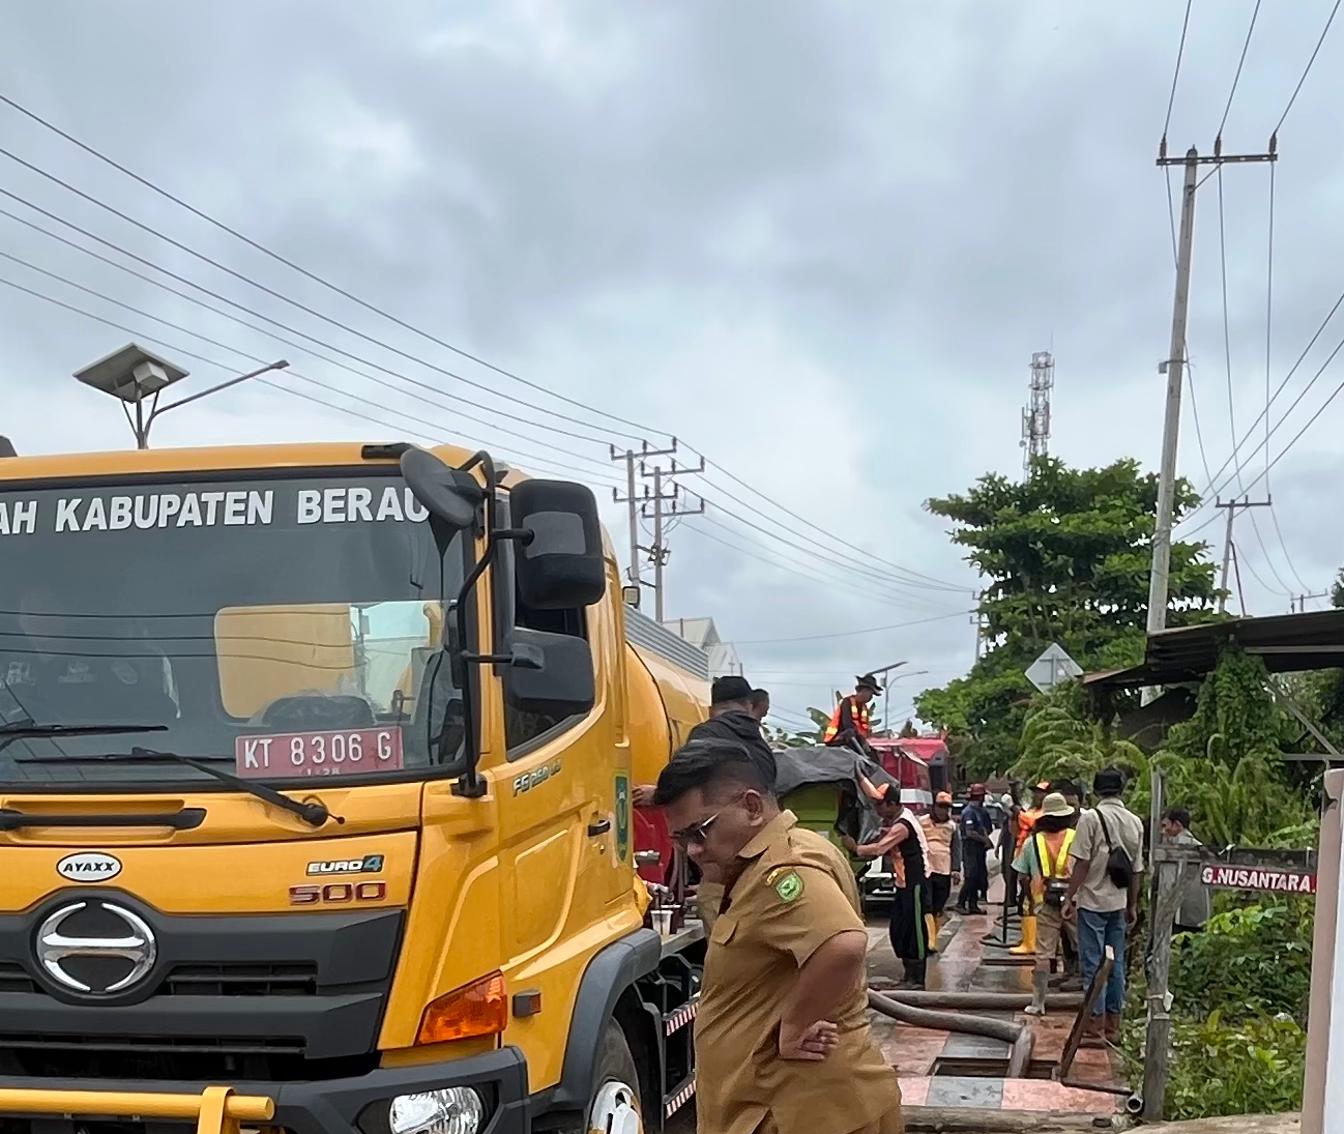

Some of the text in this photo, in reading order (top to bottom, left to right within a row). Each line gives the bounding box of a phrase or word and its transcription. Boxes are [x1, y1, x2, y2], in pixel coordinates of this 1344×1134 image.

[55, 490, 274, 532] KABUPATEN
[297, 487, 430, 524] BERAU
[244, 731, 392, 768] KT 8306 G
[62, 861, 116, 873] AYAXX
[289, 880, 387, 905] 500
